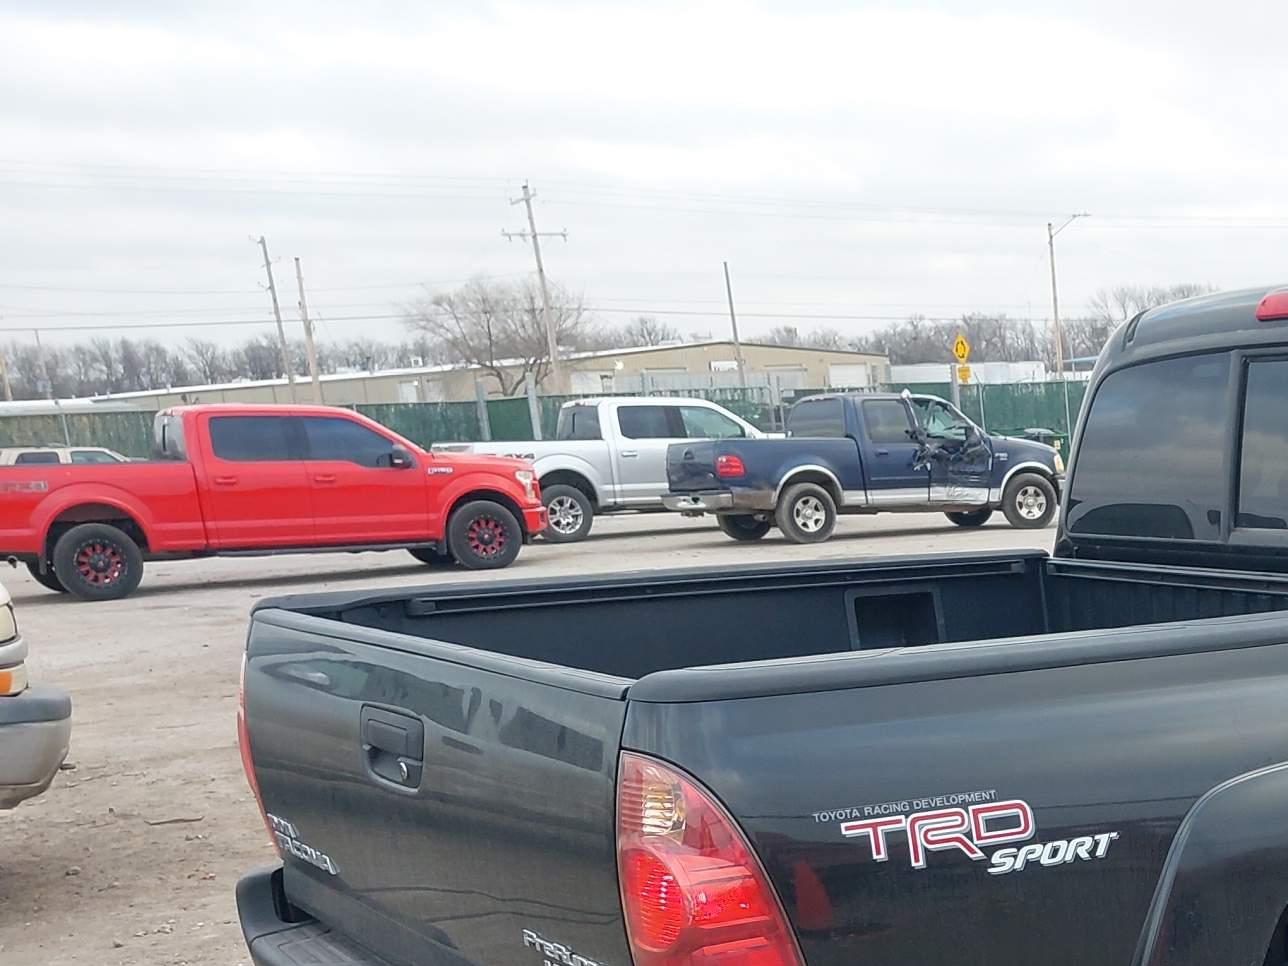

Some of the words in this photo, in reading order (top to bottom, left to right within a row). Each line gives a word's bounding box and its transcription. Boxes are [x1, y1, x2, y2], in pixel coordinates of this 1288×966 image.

[812, 808, 861, 824] TOYOTA
[864, 801, 911, 817] RACING
[913, 789, 997, 810] DEVELOPMENT
[841, 799, 1036, 869] TRD
[987, 831, 1121, 875] SPORT
